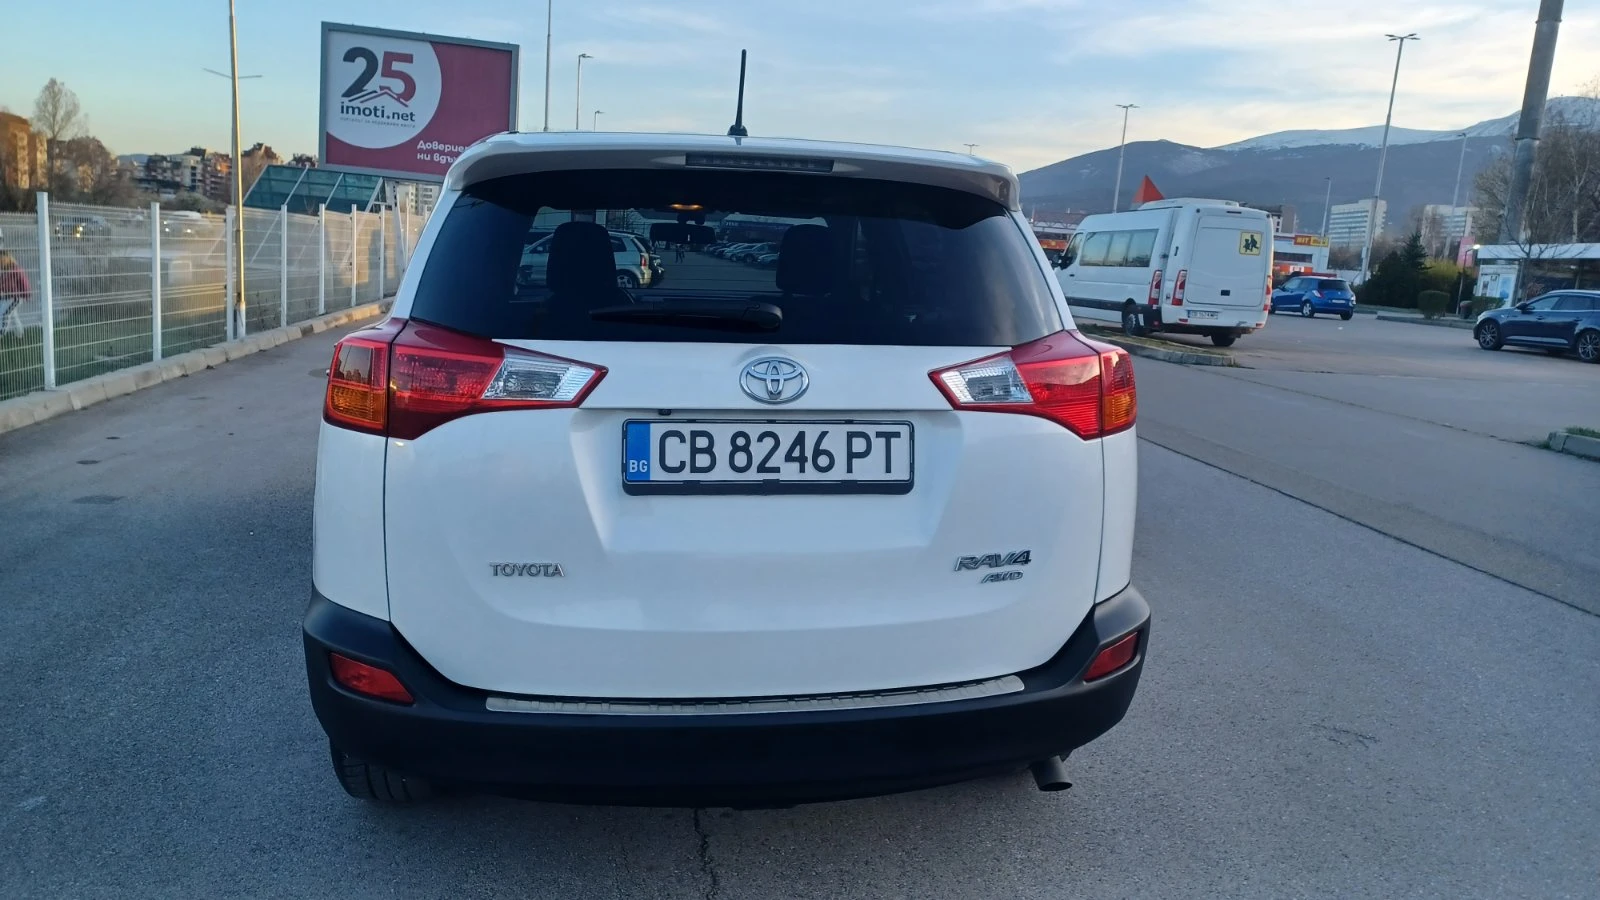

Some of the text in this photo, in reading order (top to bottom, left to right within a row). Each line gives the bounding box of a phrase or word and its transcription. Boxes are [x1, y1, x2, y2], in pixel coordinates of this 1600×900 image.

[340, 46, 417, 103] 25
[340, 101, 416, 122] imoti.net
[658, 430, 901, 473] CB 8246 PT
[629, 459, 648, 473] BG
[489, 561, 565, 577] TOYOTA
[954, 549, 1032, 571] RAV4
[981, 569, 1024, 583] AWD
